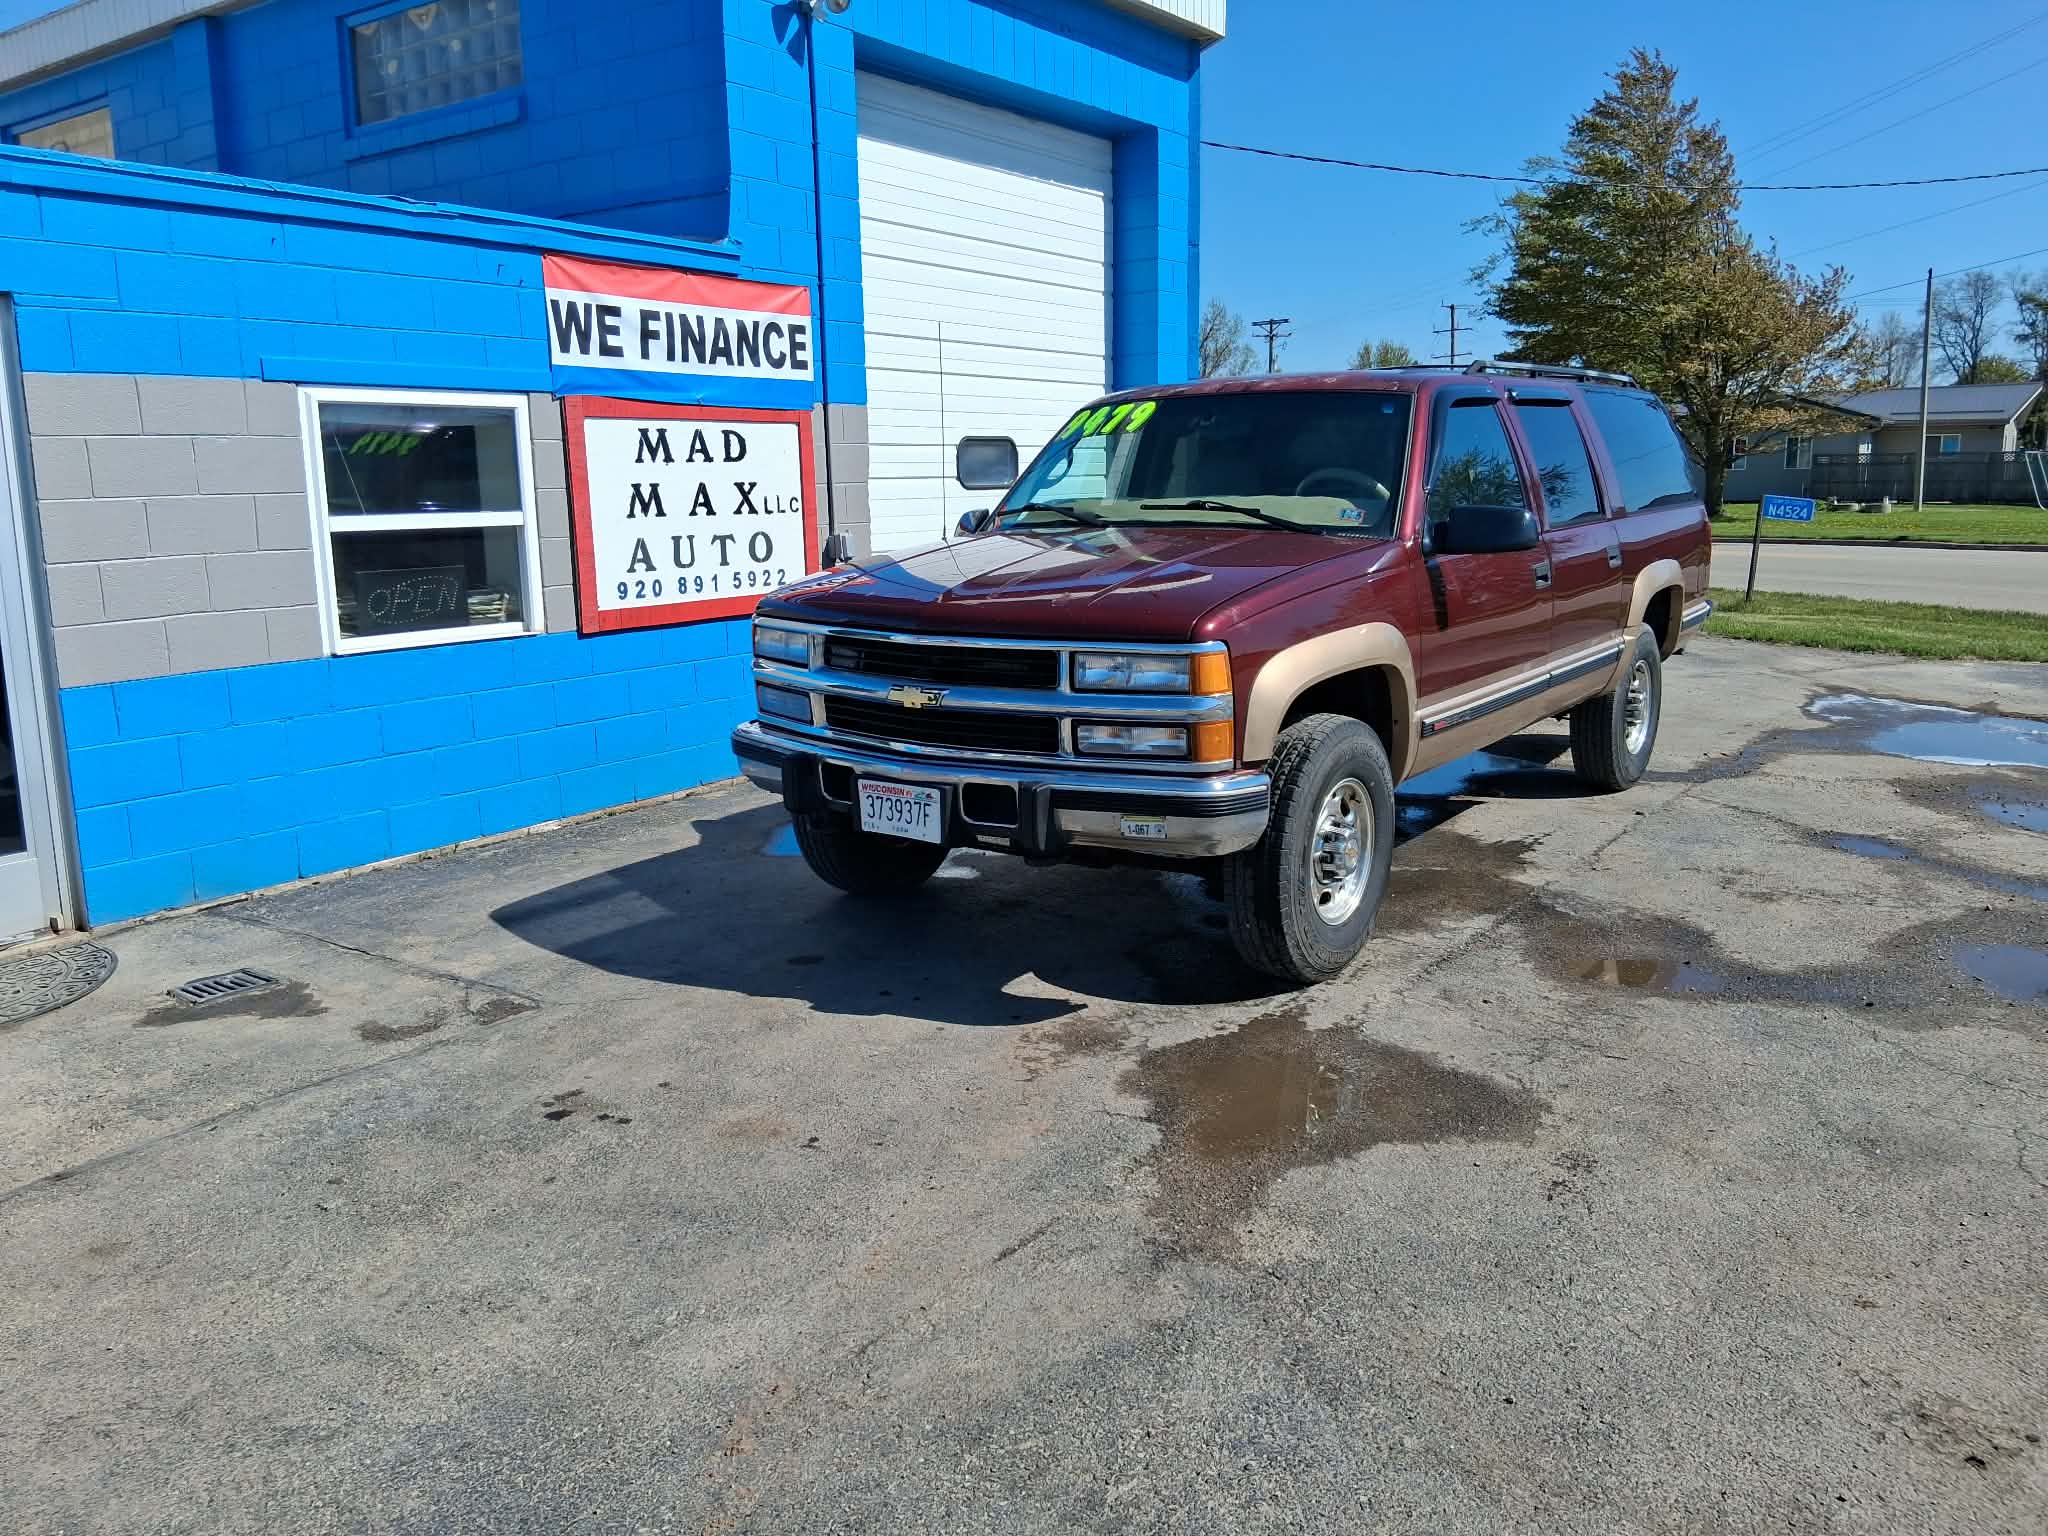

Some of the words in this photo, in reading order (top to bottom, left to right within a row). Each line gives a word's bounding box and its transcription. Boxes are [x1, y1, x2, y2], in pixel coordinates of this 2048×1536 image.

[550, 299, 625, 358] WE
[639, 308, 809, 371] FINANCE
[634, 427, 748, 464] MAD
[626, 481, 759, 519] MAX
[763, 495, 800, 515] LLC
[1768, 503, 1808, 519] N4524
[626, 531, 773, 573] AUTO
[368, 582, 457, 616] OPEN
[617, 579, 663, 600] 920
[677, 574, 719, 595] 891
[732, 568, 787, 589] 5922
[862, 783, 905, 797] WISCONSIN
[866, 794, 931, 828] 373937F
